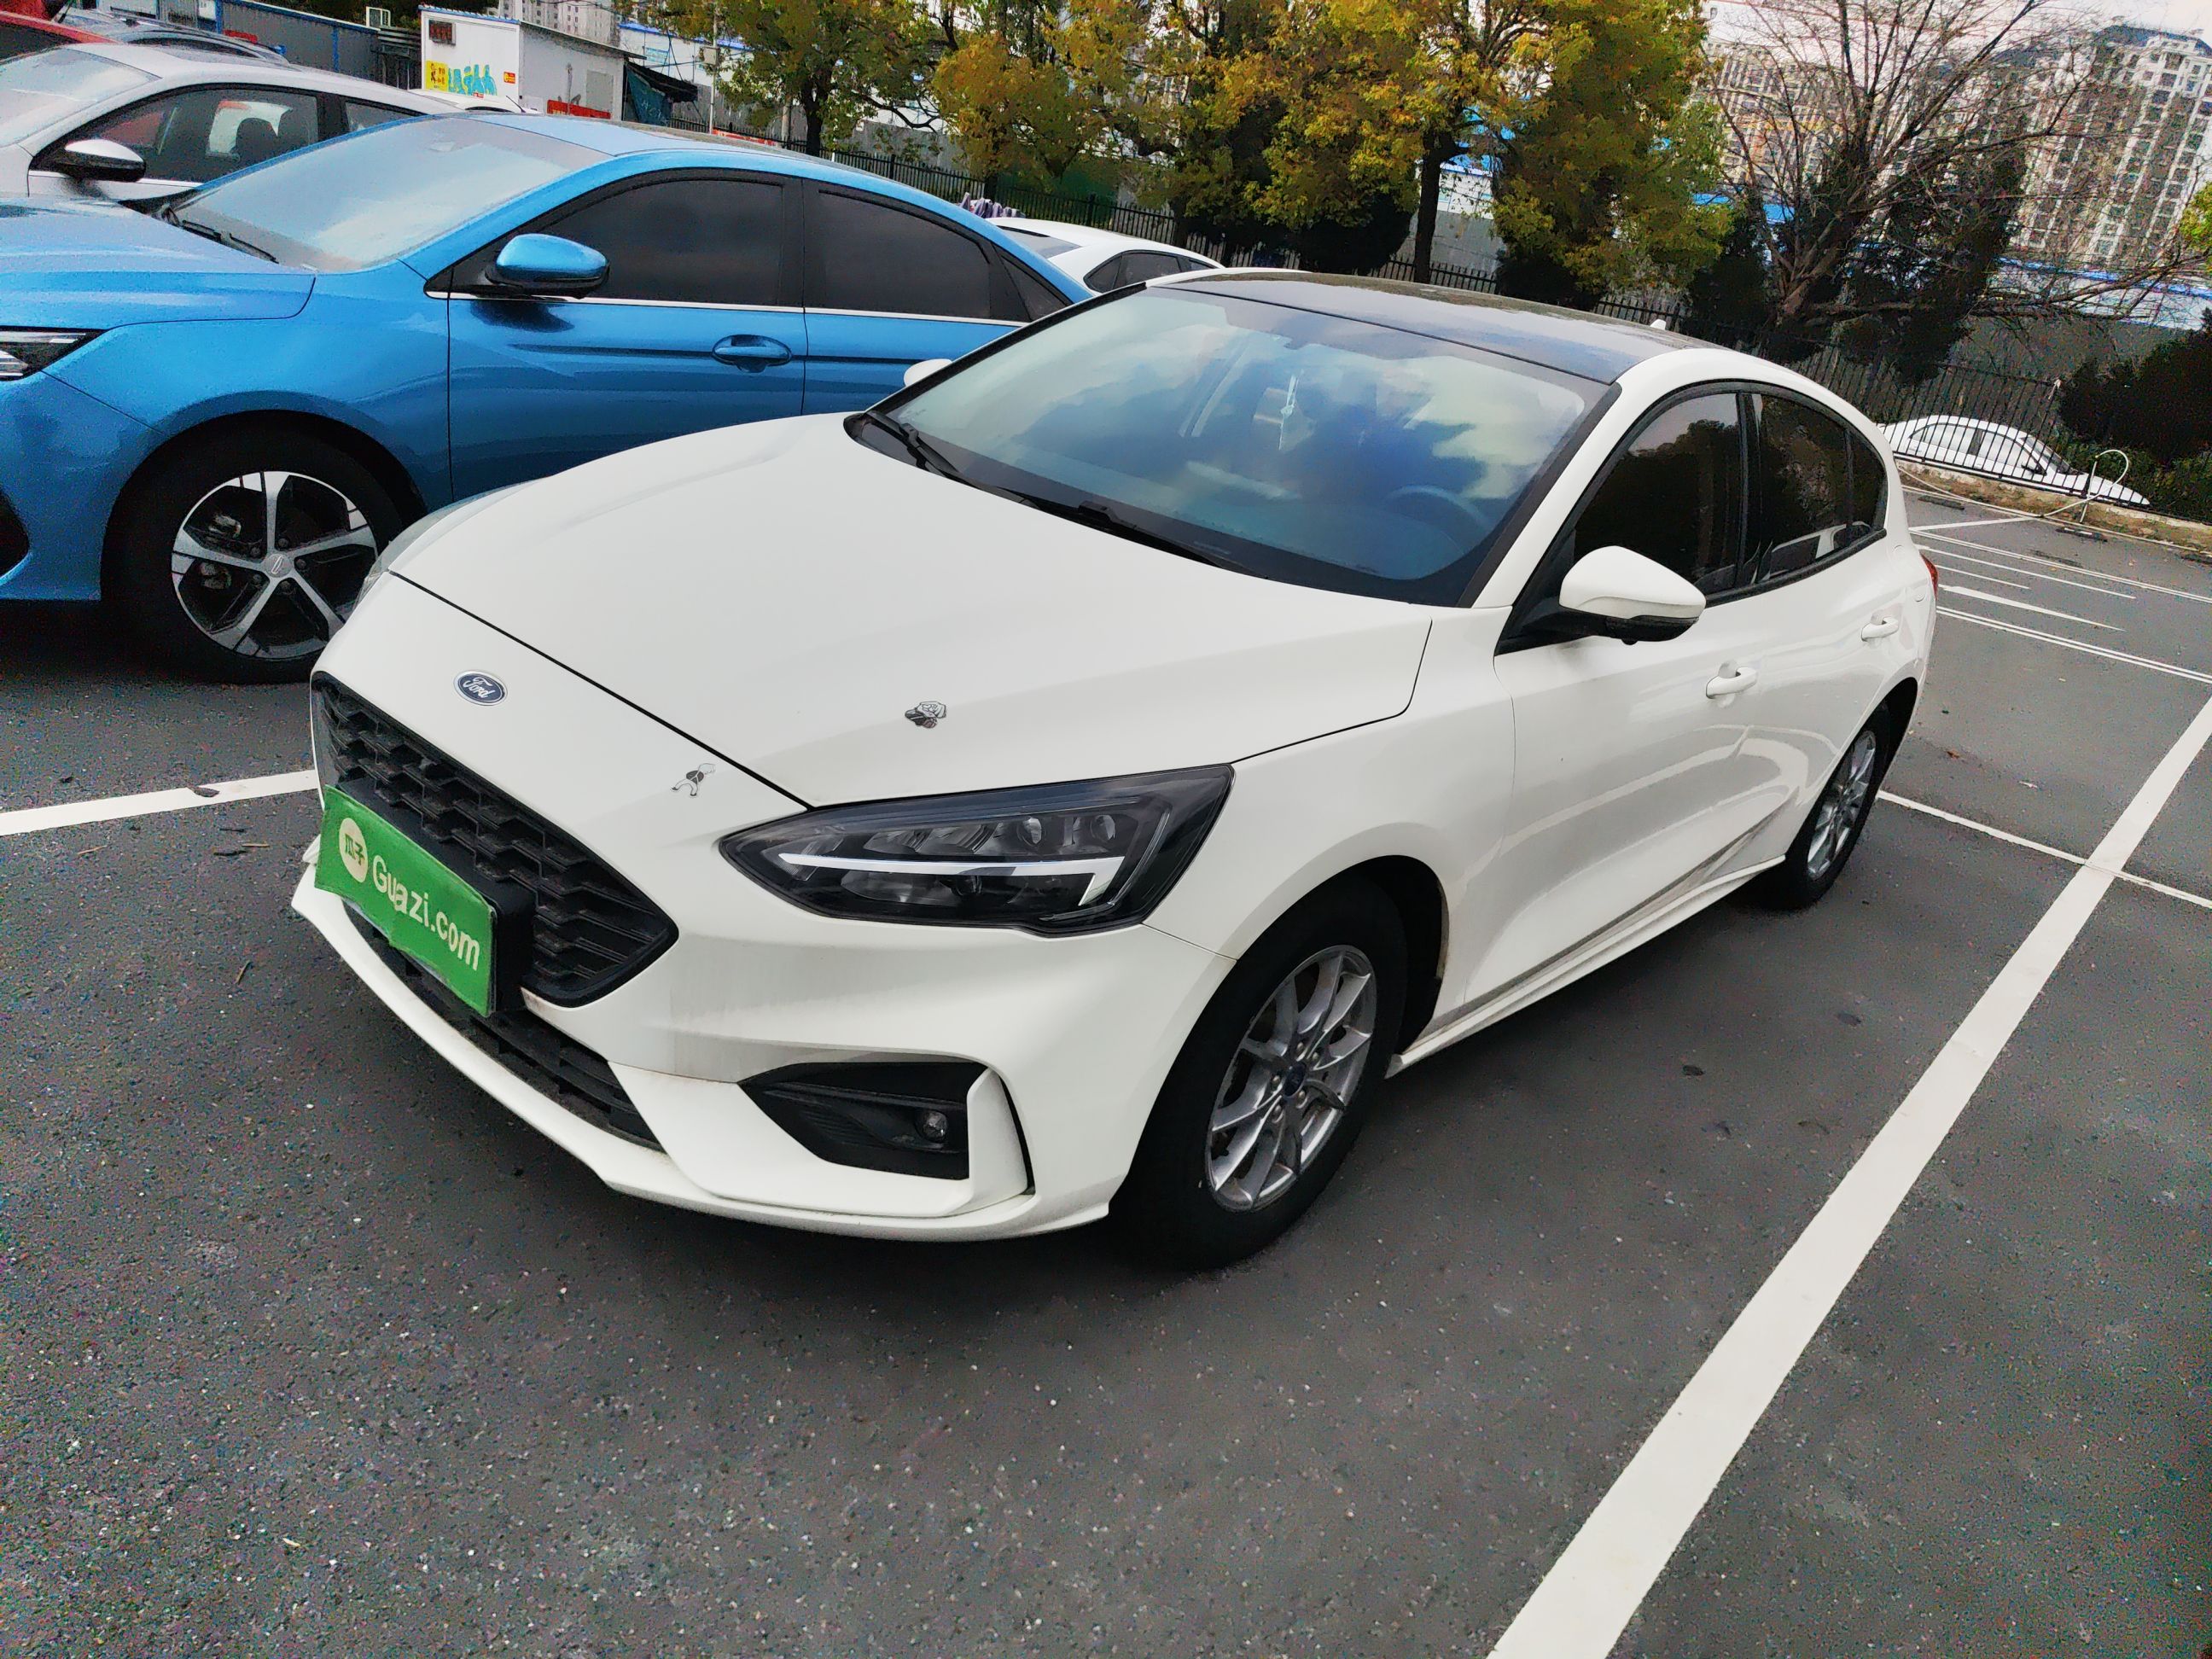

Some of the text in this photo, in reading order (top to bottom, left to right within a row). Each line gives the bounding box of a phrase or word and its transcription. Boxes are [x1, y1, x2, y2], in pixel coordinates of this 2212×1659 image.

[462, 676, 496, 698] Ford
[344, 833, 365, 865] 瓜子
[373, 855, 480, 970] Guazi.com
